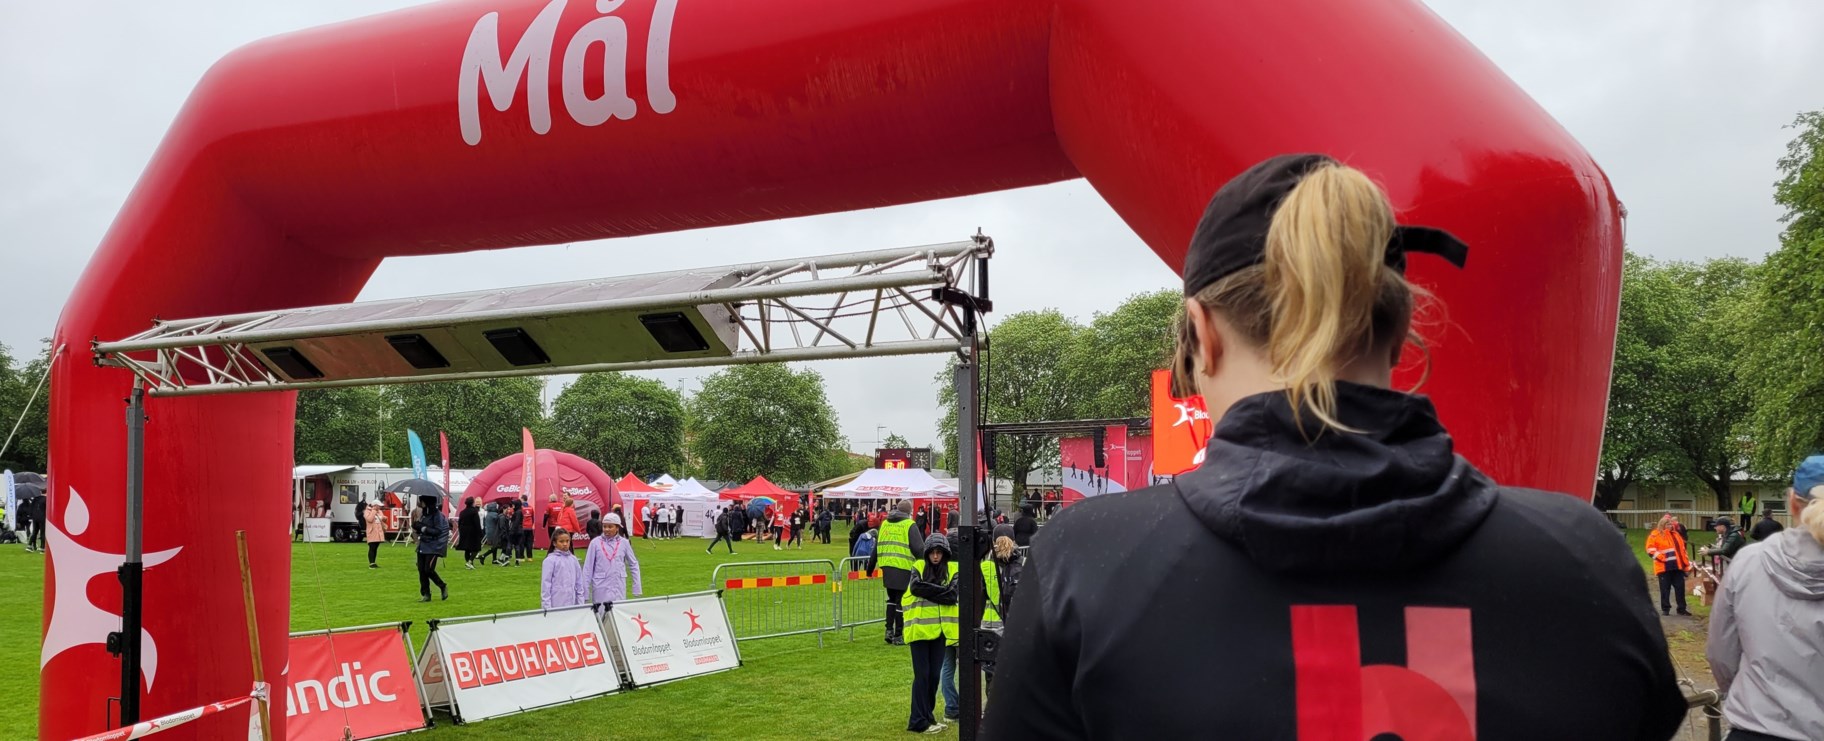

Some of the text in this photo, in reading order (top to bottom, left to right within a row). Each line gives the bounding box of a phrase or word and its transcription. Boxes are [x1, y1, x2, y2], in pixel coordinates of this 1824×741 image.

[458, 0, 678, 146] Mål
[632, 642, 672, 656] Blodomloppet
[683, 635, 722, 649] Blodomloppet
[452, 633, 605, 690] BAUHAUS
[160, 712, 196, 726] Blodomloppet
